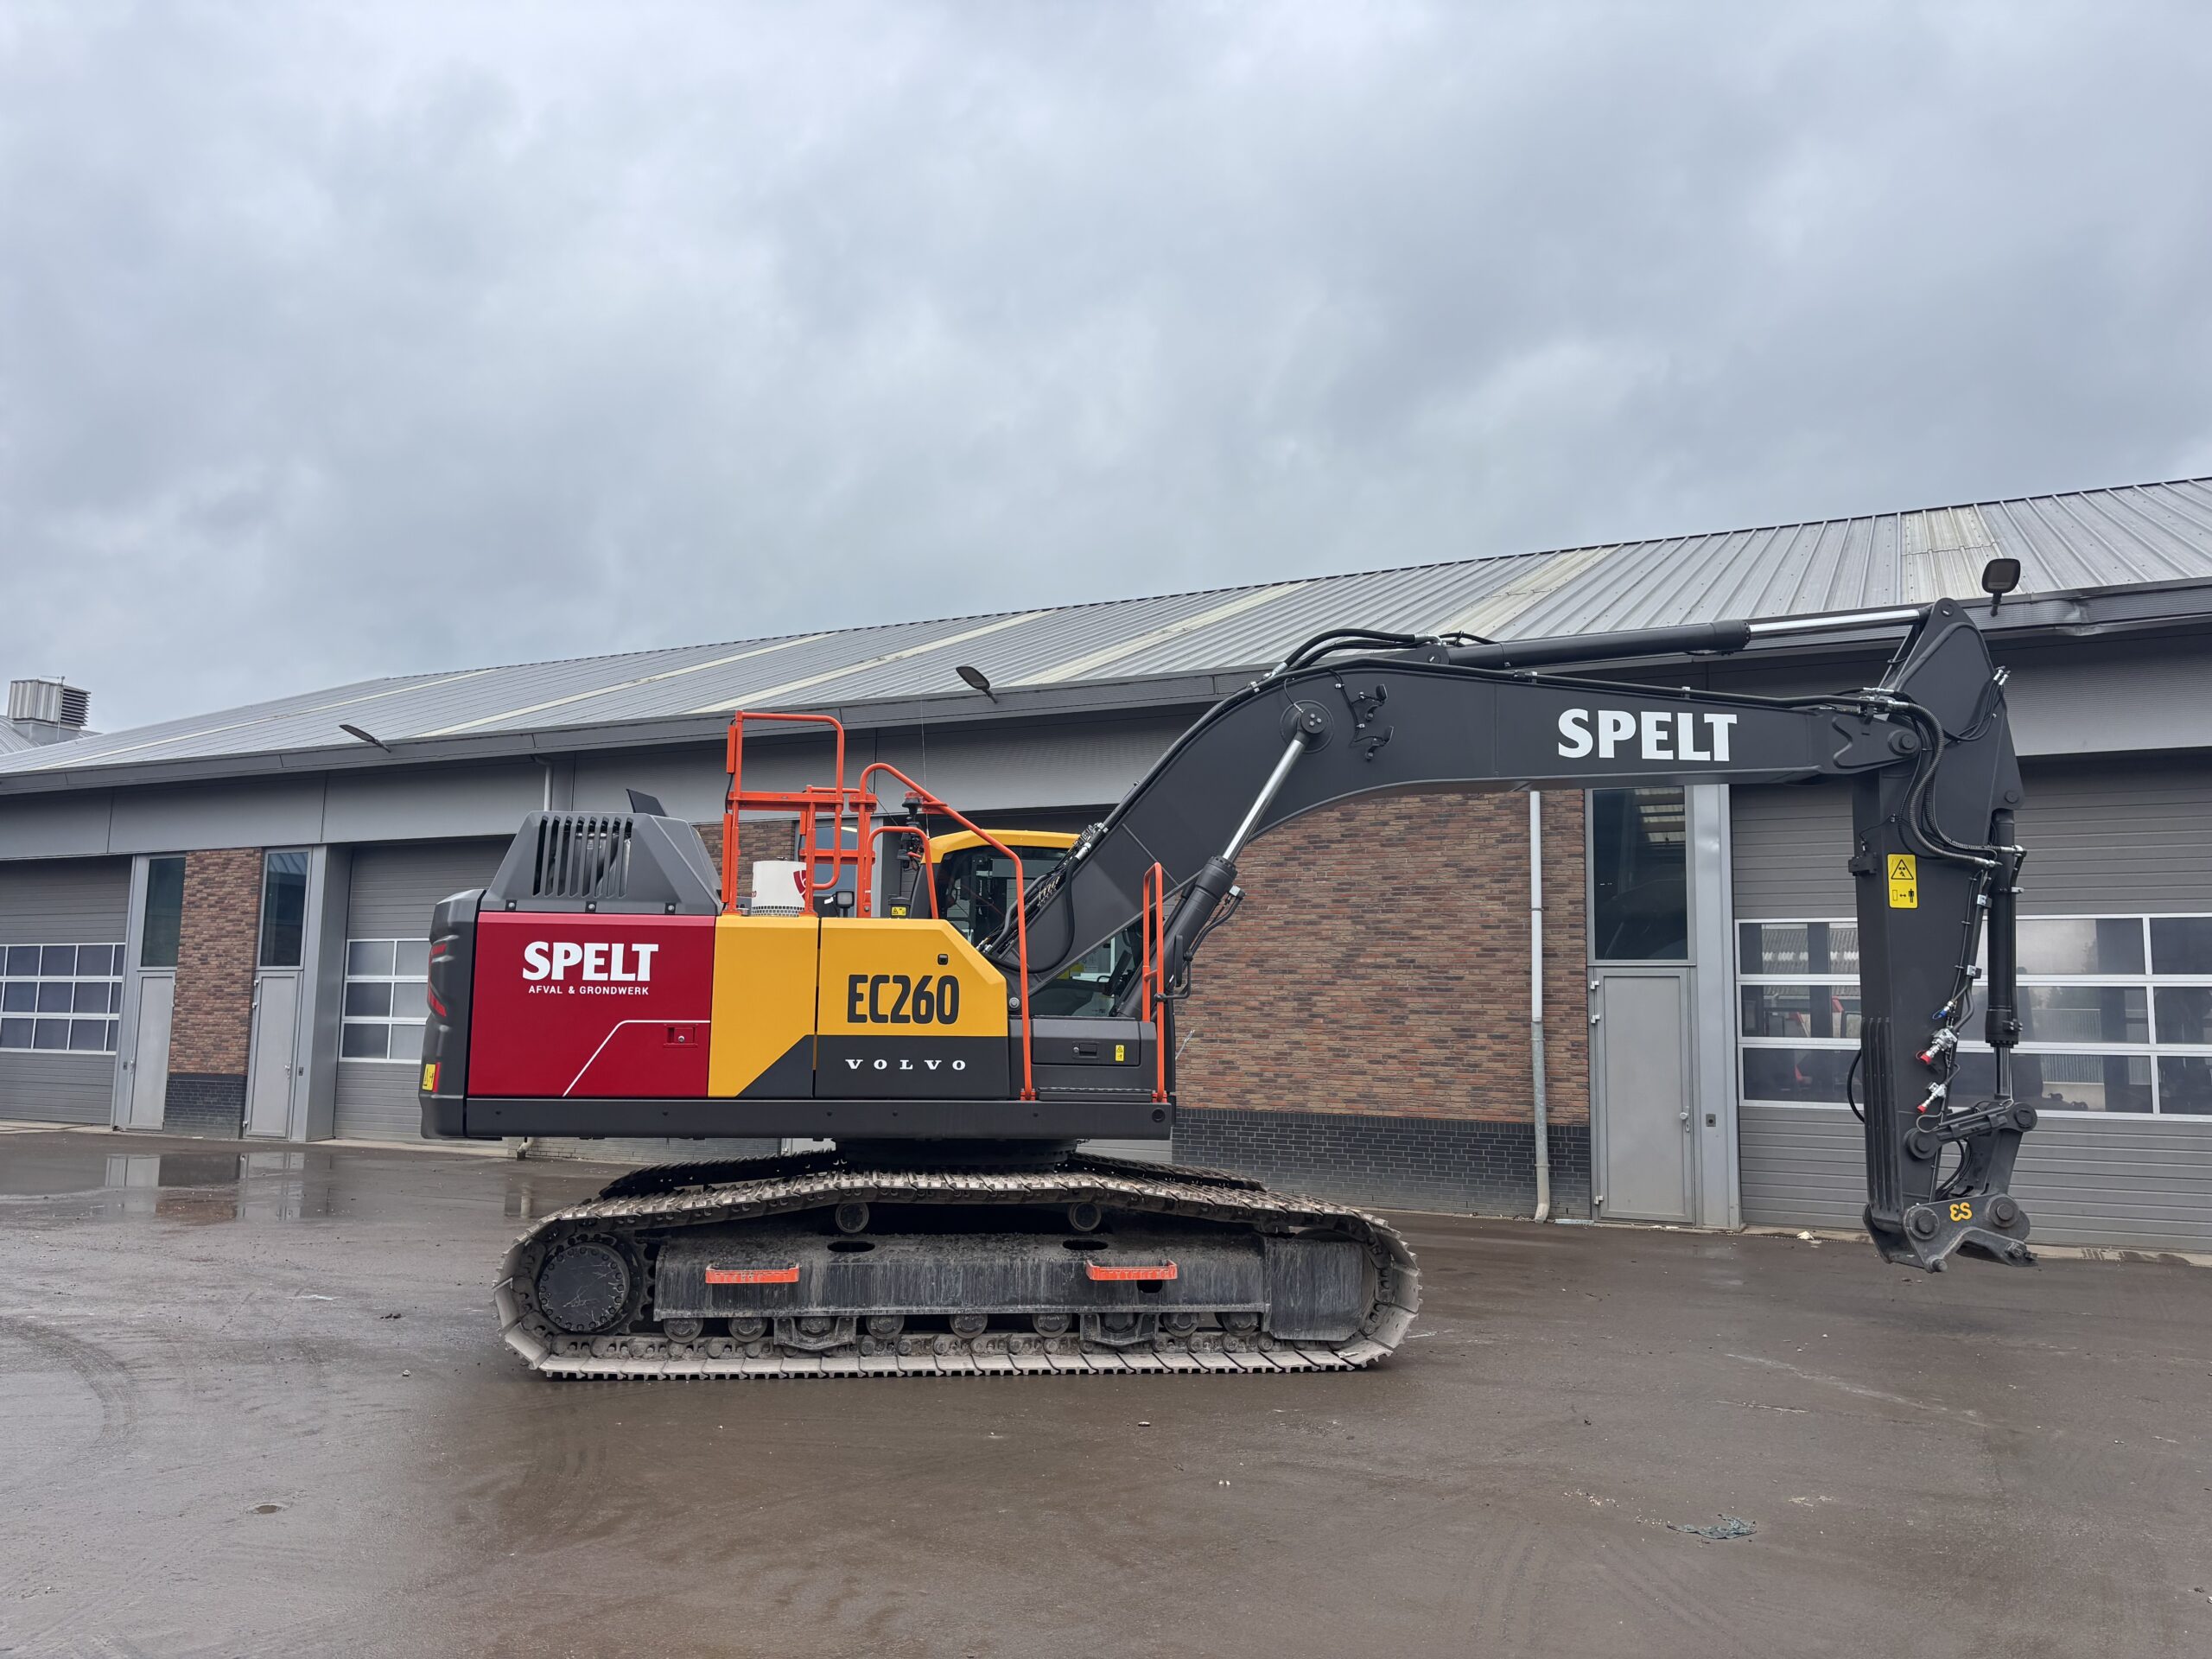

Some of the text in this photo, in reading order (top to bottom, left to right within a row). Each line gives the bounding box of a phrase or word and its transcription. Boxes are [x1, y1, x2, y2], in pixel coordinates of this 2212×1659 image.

[1558, 708, 1738, 762] SPELT
[522, 940, 659, 982] SPELT
[528, 985, 650, 995] AFVAL & GRONDWERK
[847, 974, 960, 1025] EC260
[844, 1058, 966, 1071] VOLVO
